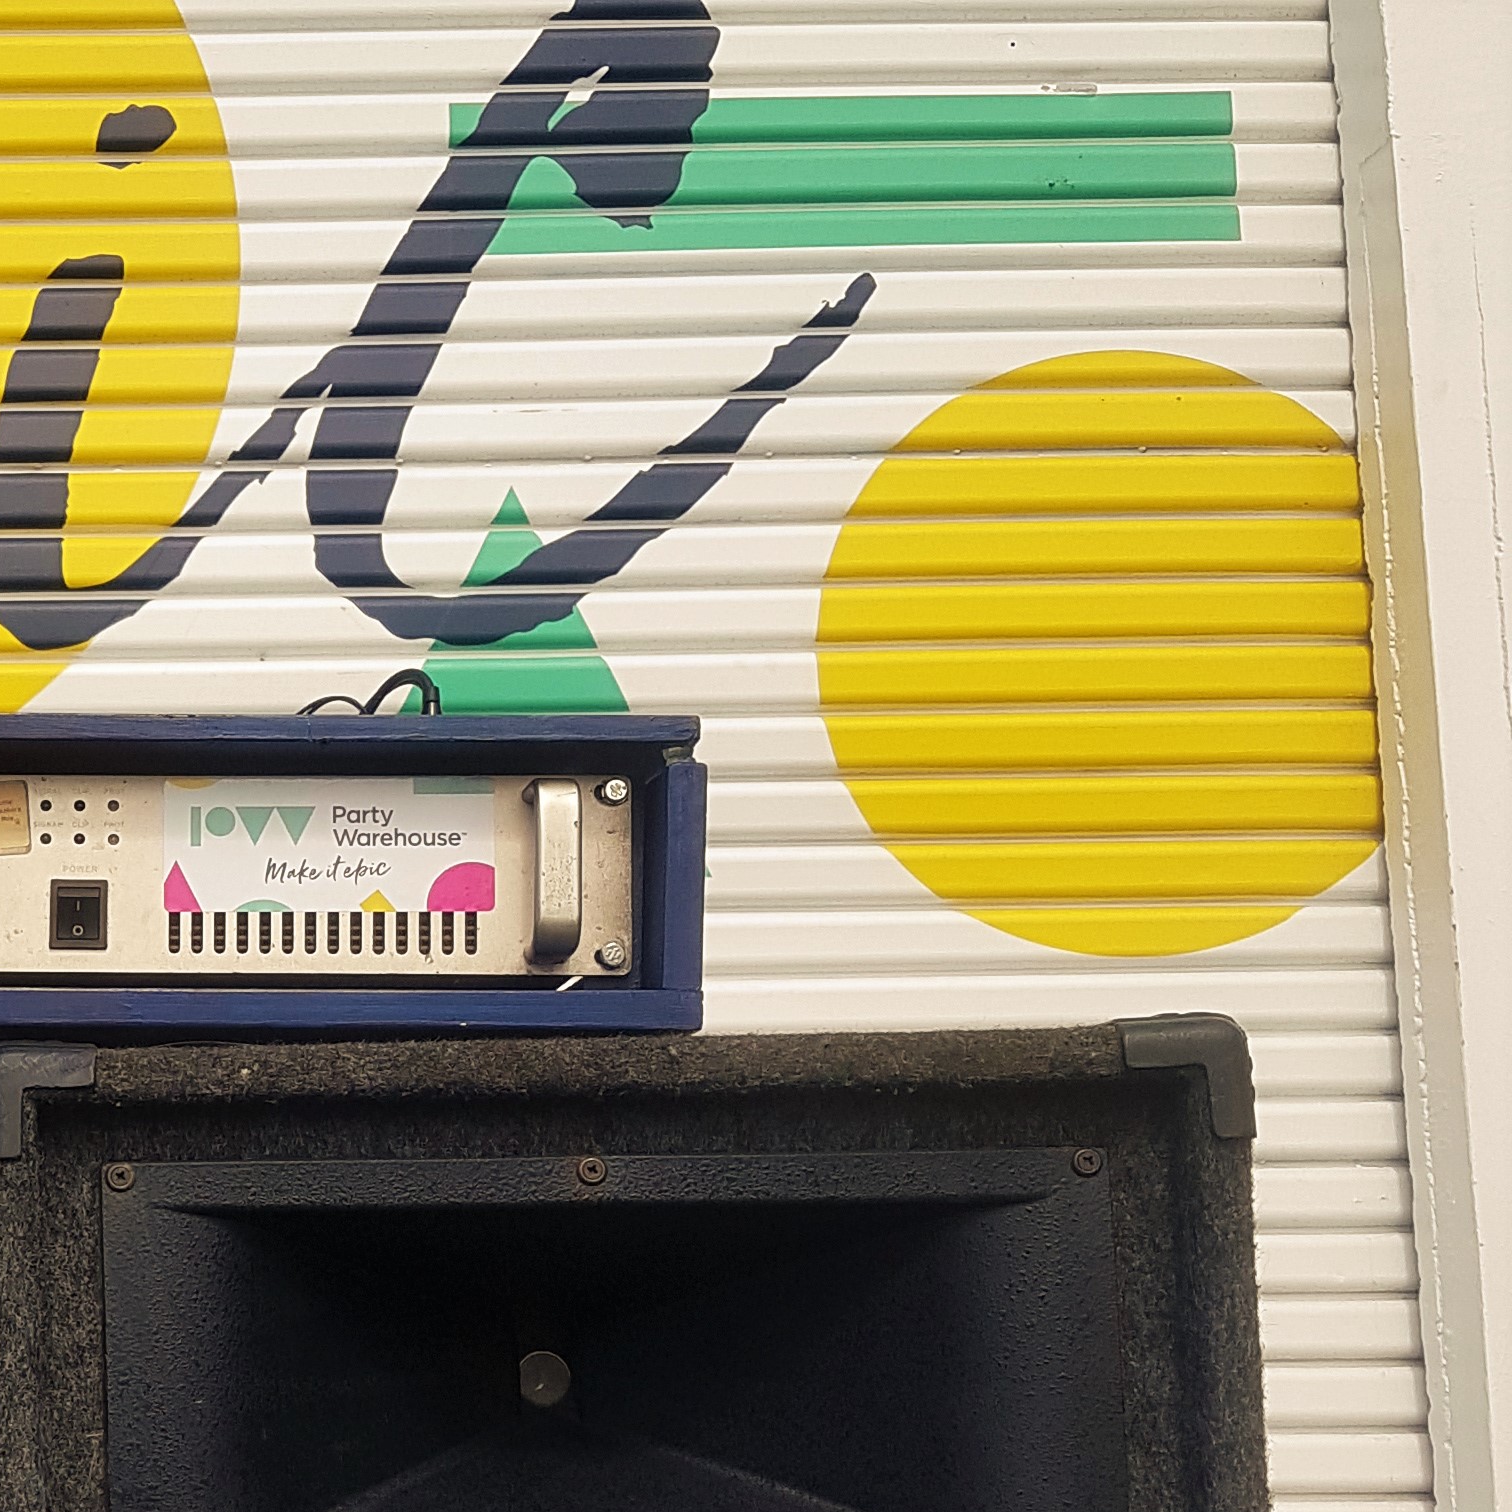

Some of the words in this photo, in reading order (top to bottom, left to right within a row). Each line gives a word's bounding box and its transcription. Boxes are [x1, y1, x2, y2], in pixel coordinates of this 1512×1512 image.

[332, 806, 394, 827] Party
[62, 864, 98, 873] POWER
[265, 857, 322, 885] Make
[326, 855, 343, 882] it
[343, 859, 392, 886] epic
